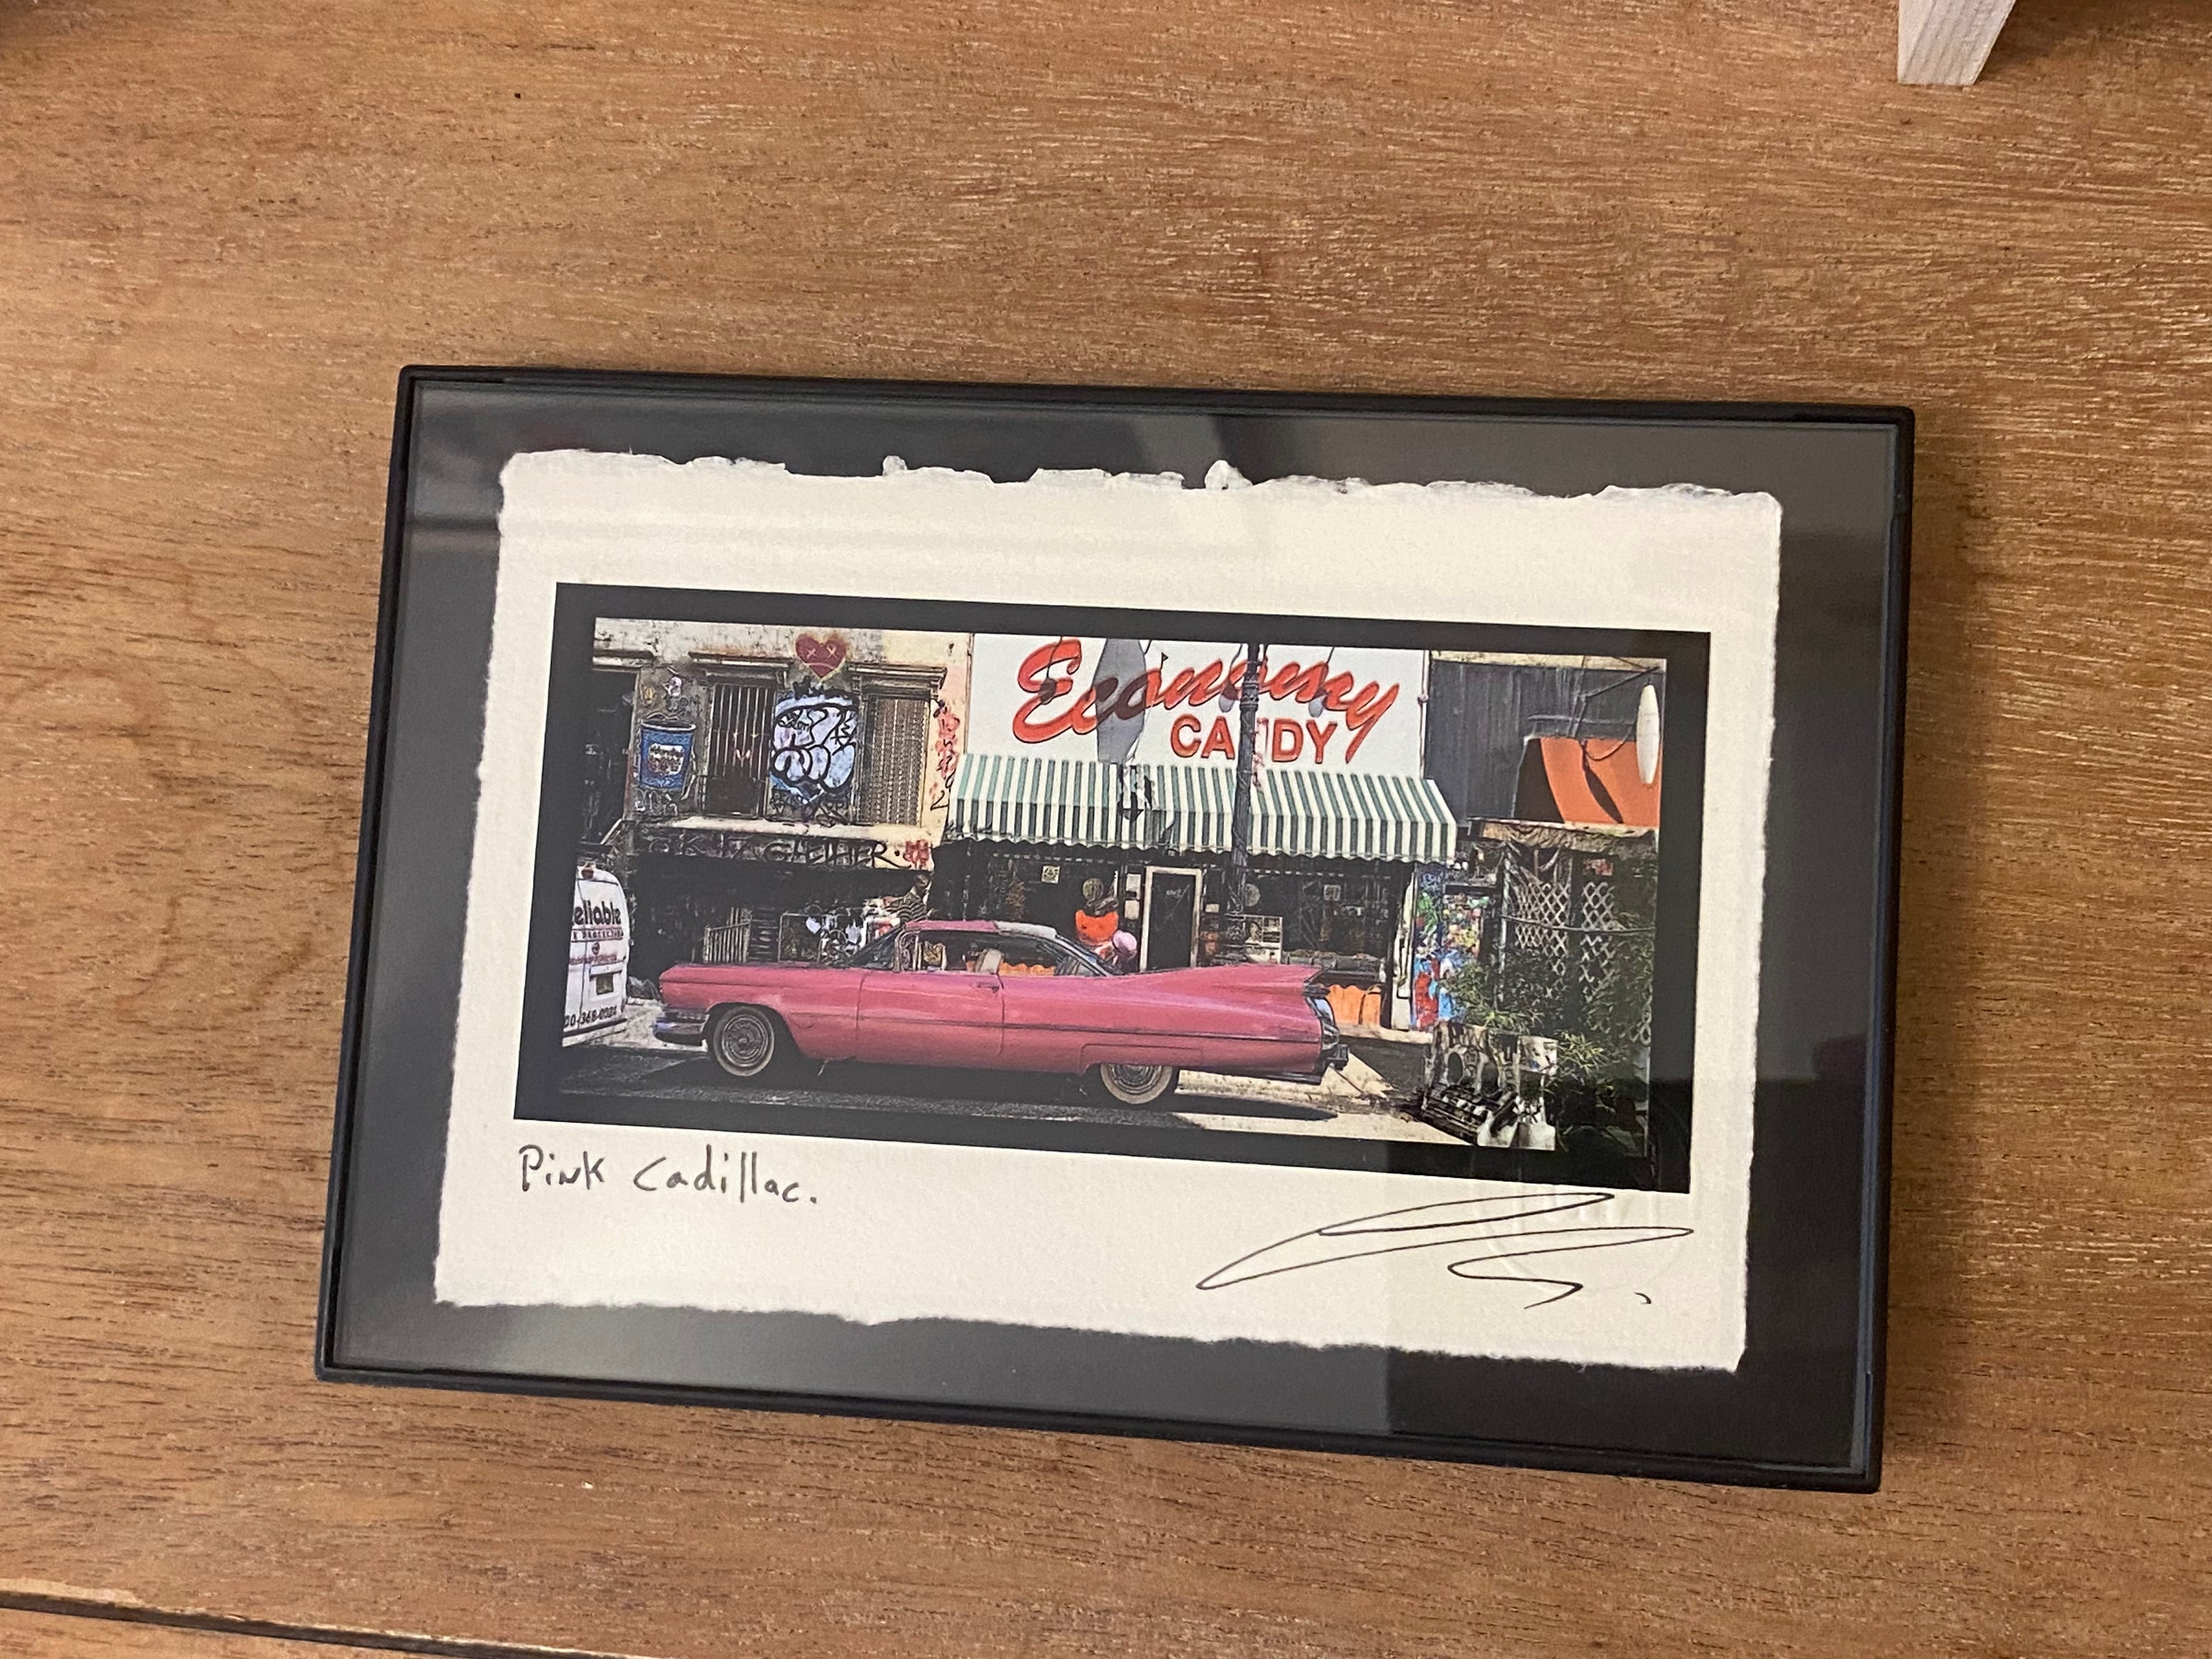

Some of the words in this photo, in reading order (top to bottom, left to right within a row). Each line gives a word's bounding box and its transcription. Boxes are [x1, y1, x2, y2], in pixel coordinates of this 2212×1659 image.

[1170, 713, 1338, 764] CADY
[518, 1143, 605, 1192] Pink
[633, 1143, 818, 1205] Cadillac.
